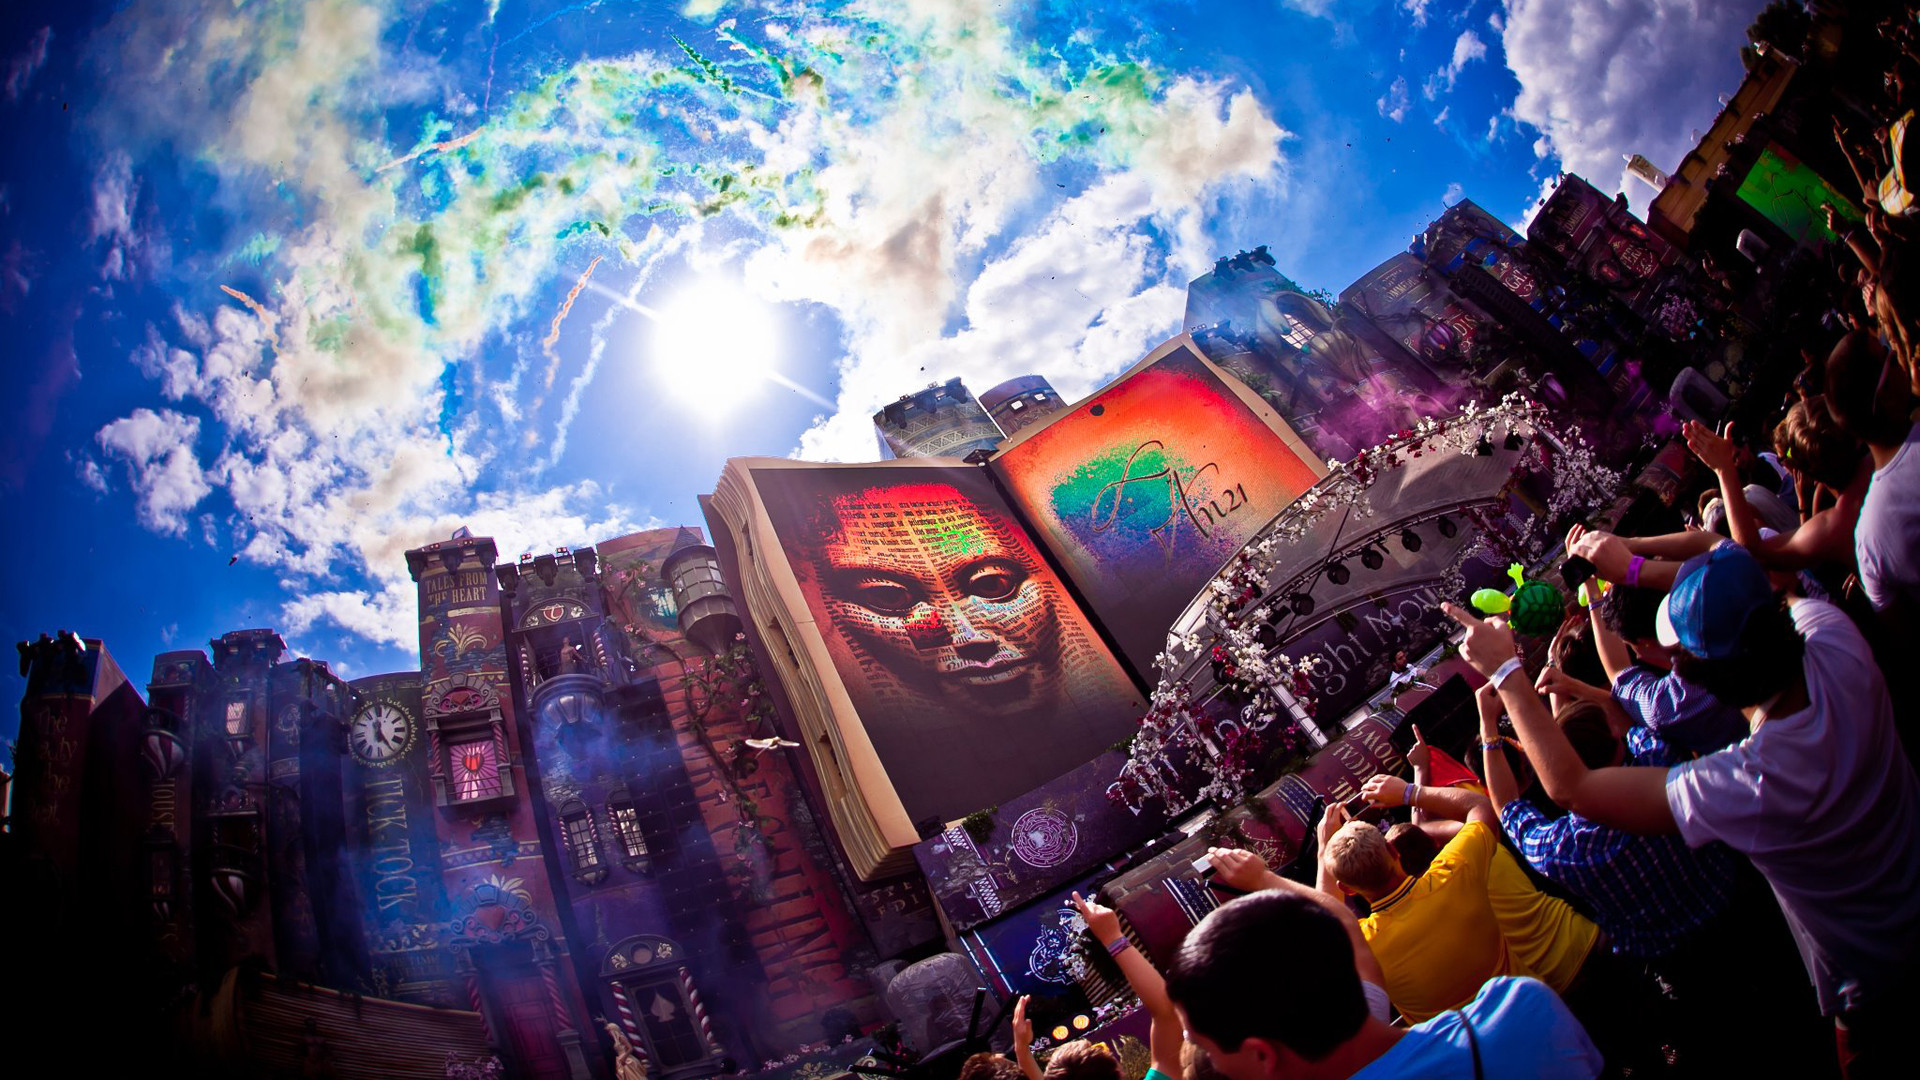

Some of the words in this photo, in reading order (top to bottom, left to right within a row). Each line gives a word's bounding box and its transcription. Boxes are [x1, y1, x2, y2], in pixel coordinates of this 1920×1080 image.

[425, 575, 455, 594] TALES
[459, 571, 488, 589] FROM
[452, 586, 487, 604] HEART
